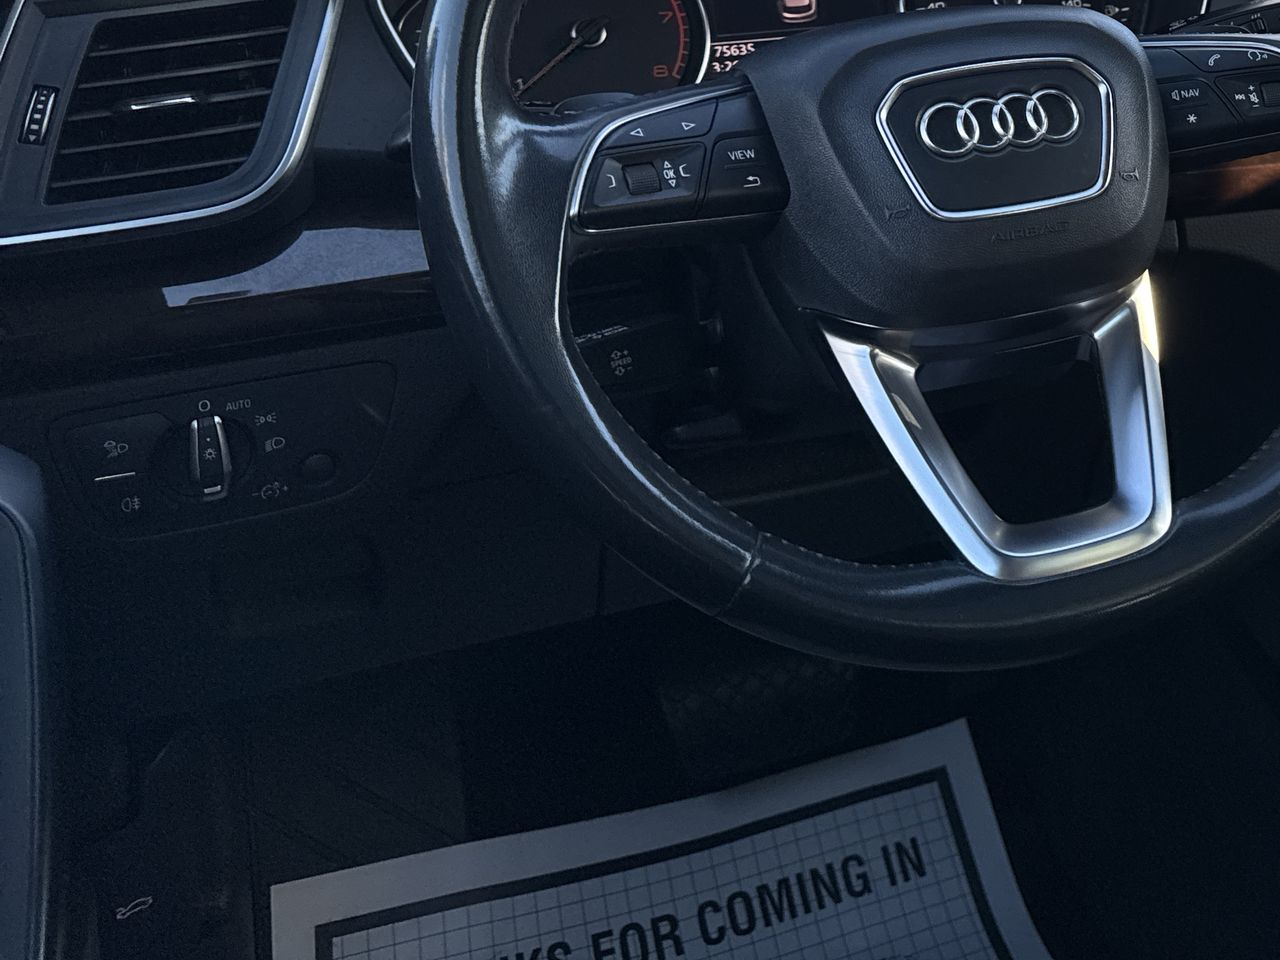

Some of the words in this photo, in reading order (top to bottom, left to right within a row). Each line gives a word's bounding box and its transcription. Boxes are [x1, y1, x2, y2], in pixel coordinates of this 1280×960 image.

[658, 11, 673, 24] 7
[1180, 88, 1200, 100] NAV
[727, 148, 756, 162] VIEW
[663, 168, 677, 180] OK
[990, 221, 1070, 243] AIRBAG
[225, 398, 252, 412] AUTO
[591, 913, 686, 960] FOR
[697, 854, 873, 946] COMING
[882, 837, 928, 888] IN
